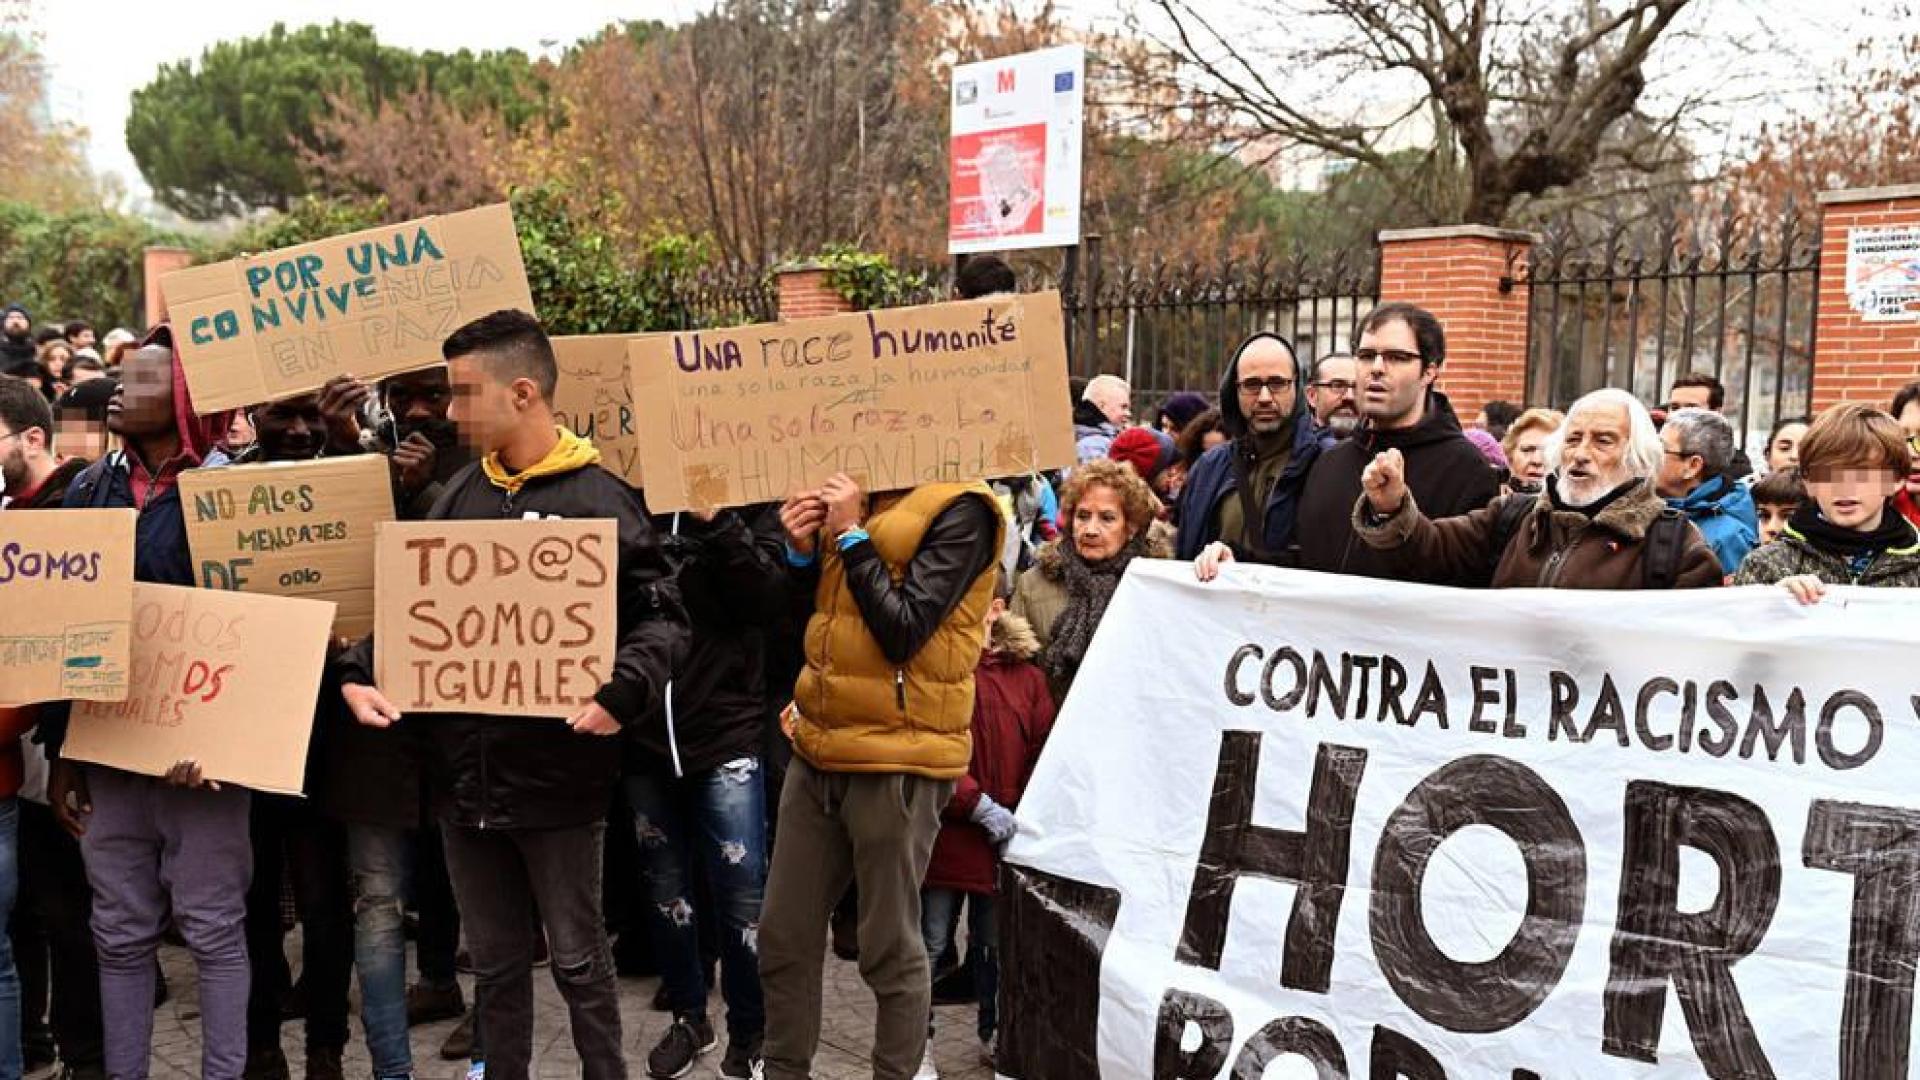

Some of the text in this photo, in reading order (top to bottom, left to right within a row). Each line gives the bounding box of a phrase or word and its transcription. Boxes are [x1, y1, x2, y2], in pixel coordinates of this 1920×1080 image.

[245, 226, 444, 297] POR UNA
[189, 254, 504, 345] CONVIVENCIA
[270, 330, 336, 377] EN
[674, 334, 743, 373] UNA
[867, 308, 1016, 360] humanité
[194, 487, 235, 522] NO
[237, 520, 348, 552] MENSAJES
[405, 533, 607, 588] TOD@S
[408, 600, 596, 652] SOMOS
[132, 651, 236, 702] OMOS
[411, 655, 603, 708] IGUALES
[1223, 643, 1884, 771] CONTRA EL RACISMO
[1174, 730, 1920, 1080] HORT
